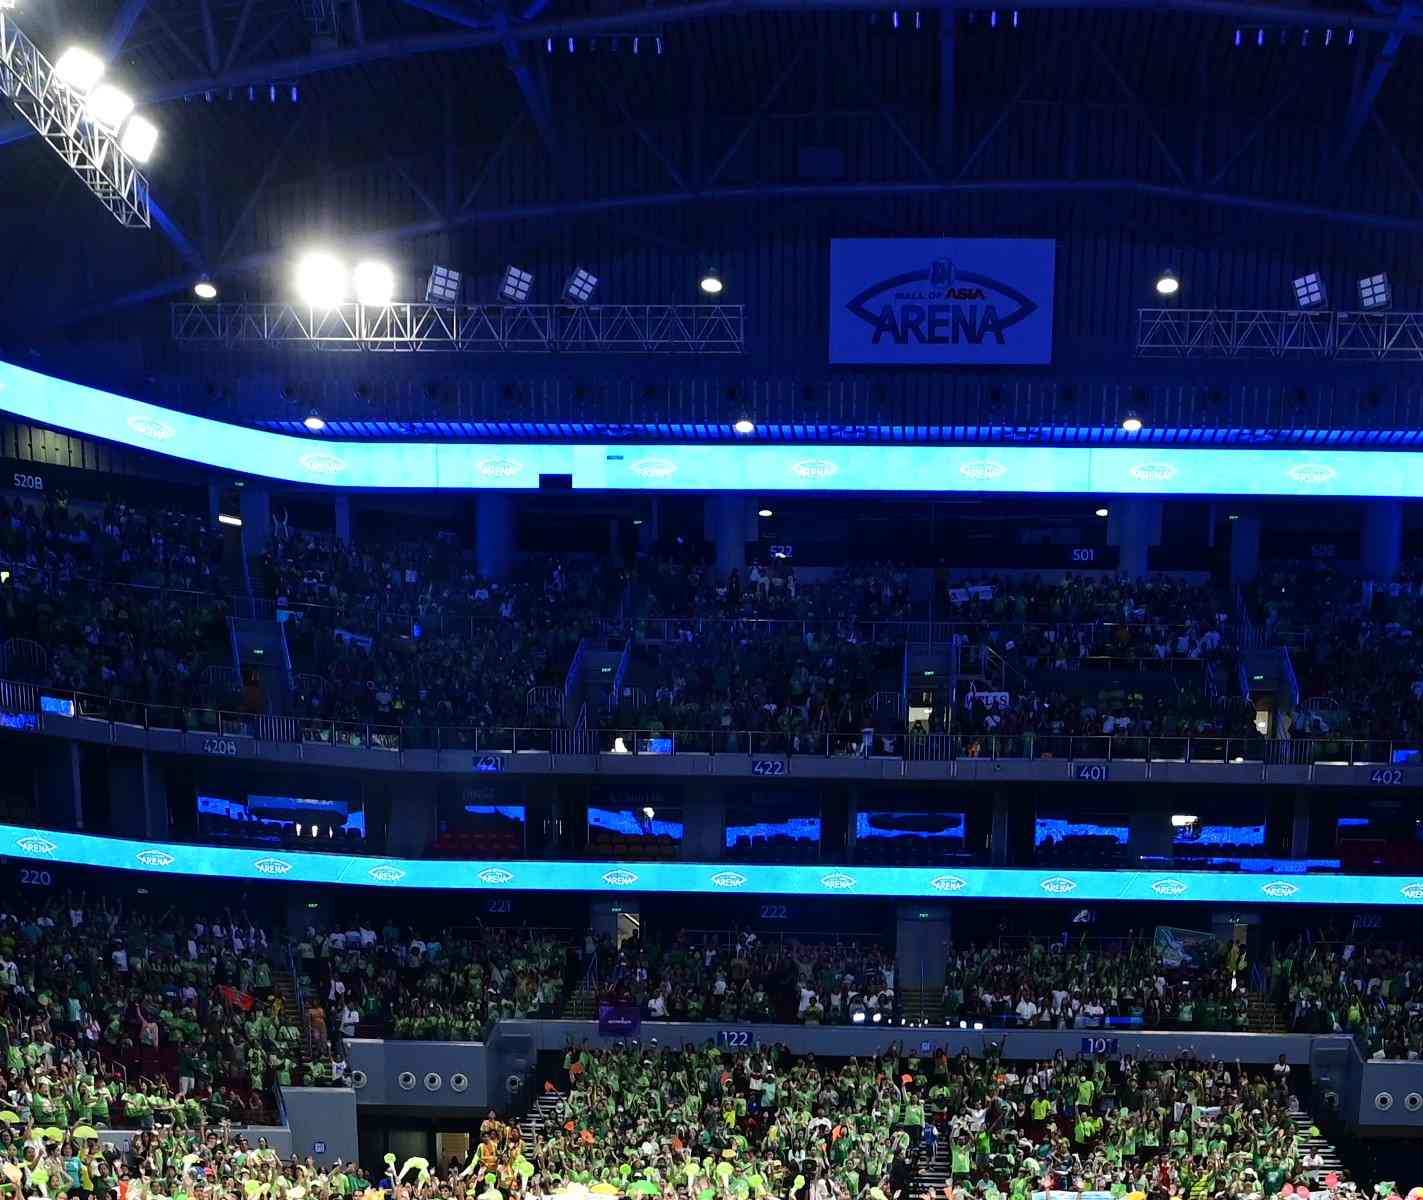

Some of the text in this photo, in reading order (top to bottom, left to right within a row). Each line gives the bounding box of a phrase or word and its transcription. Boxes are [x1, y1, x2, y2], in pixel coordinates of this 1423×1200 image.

[946, 288, 985, 300] ASIA
[873, 305, 1005, 344] ARENA
[14, 475, 43, 490] 520B
[1073, 549, 1095, 561] 501
[754, 761, 785, 775] 422
[1080, 766, 1107, 780] 401
[1372, 769, 1401, 785] 402
[260, 864, 289, 874] ARENA
[21, 869, 51, 886] 220
[487, 900, 511, 913] 221
[722, 1032, 750, 1047] 122
